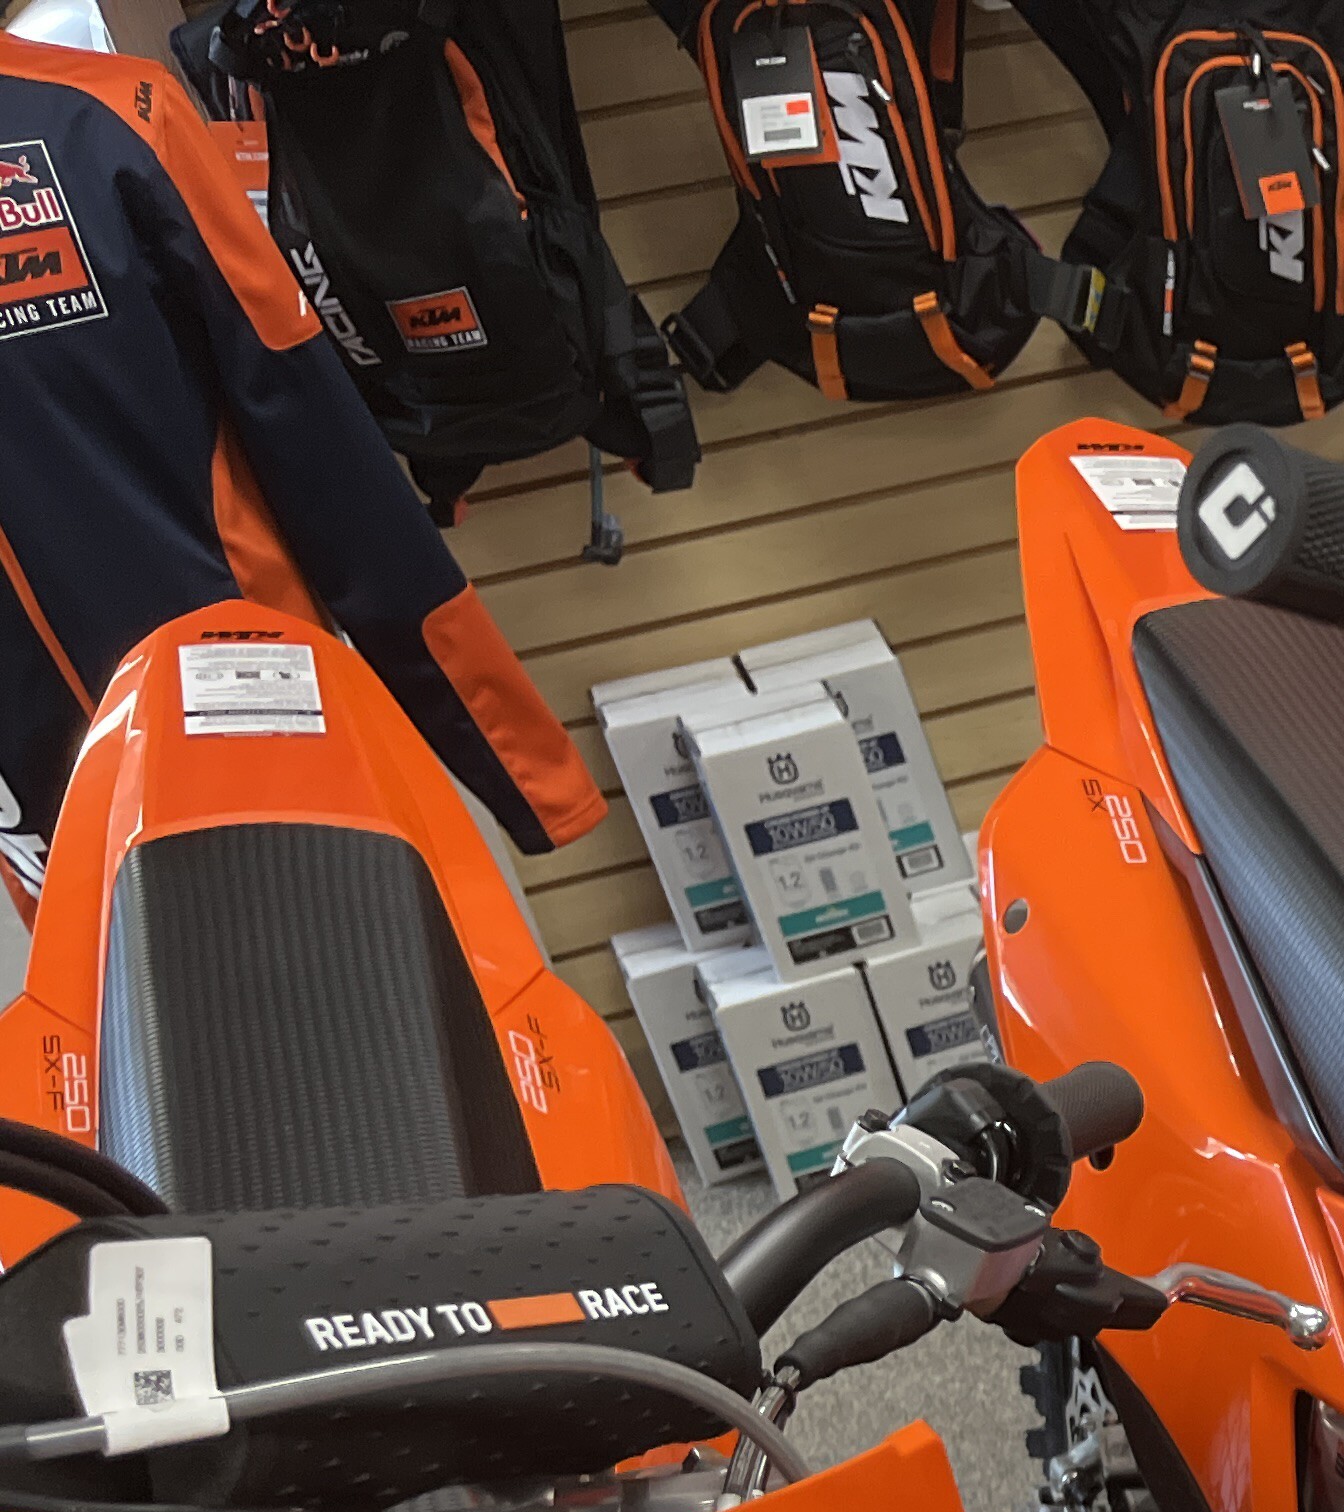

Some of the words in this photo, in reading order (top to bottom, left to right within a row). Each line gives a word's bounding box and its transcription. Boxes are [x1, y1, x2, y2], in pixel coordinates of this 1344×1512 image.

[823, 71, 909, 224] KTM
[0, 188, 63, 231] Bull
[0, 247, 62, 285] TM
[46, 291, 97, 318] TEAM
[1081, 779, 1108, 812] SX
[1103, 794, 1148, 864] 250
[42, 1035, 65, 1112] SX-F
[62, 1052, 91, 1132] 250
[508, 1029, 548, 1114] 250
[305, 1307, 435, 1350] READY
[436, 1301, 493, 1335] TO
[577, 1282, 669, 1320] RACE
